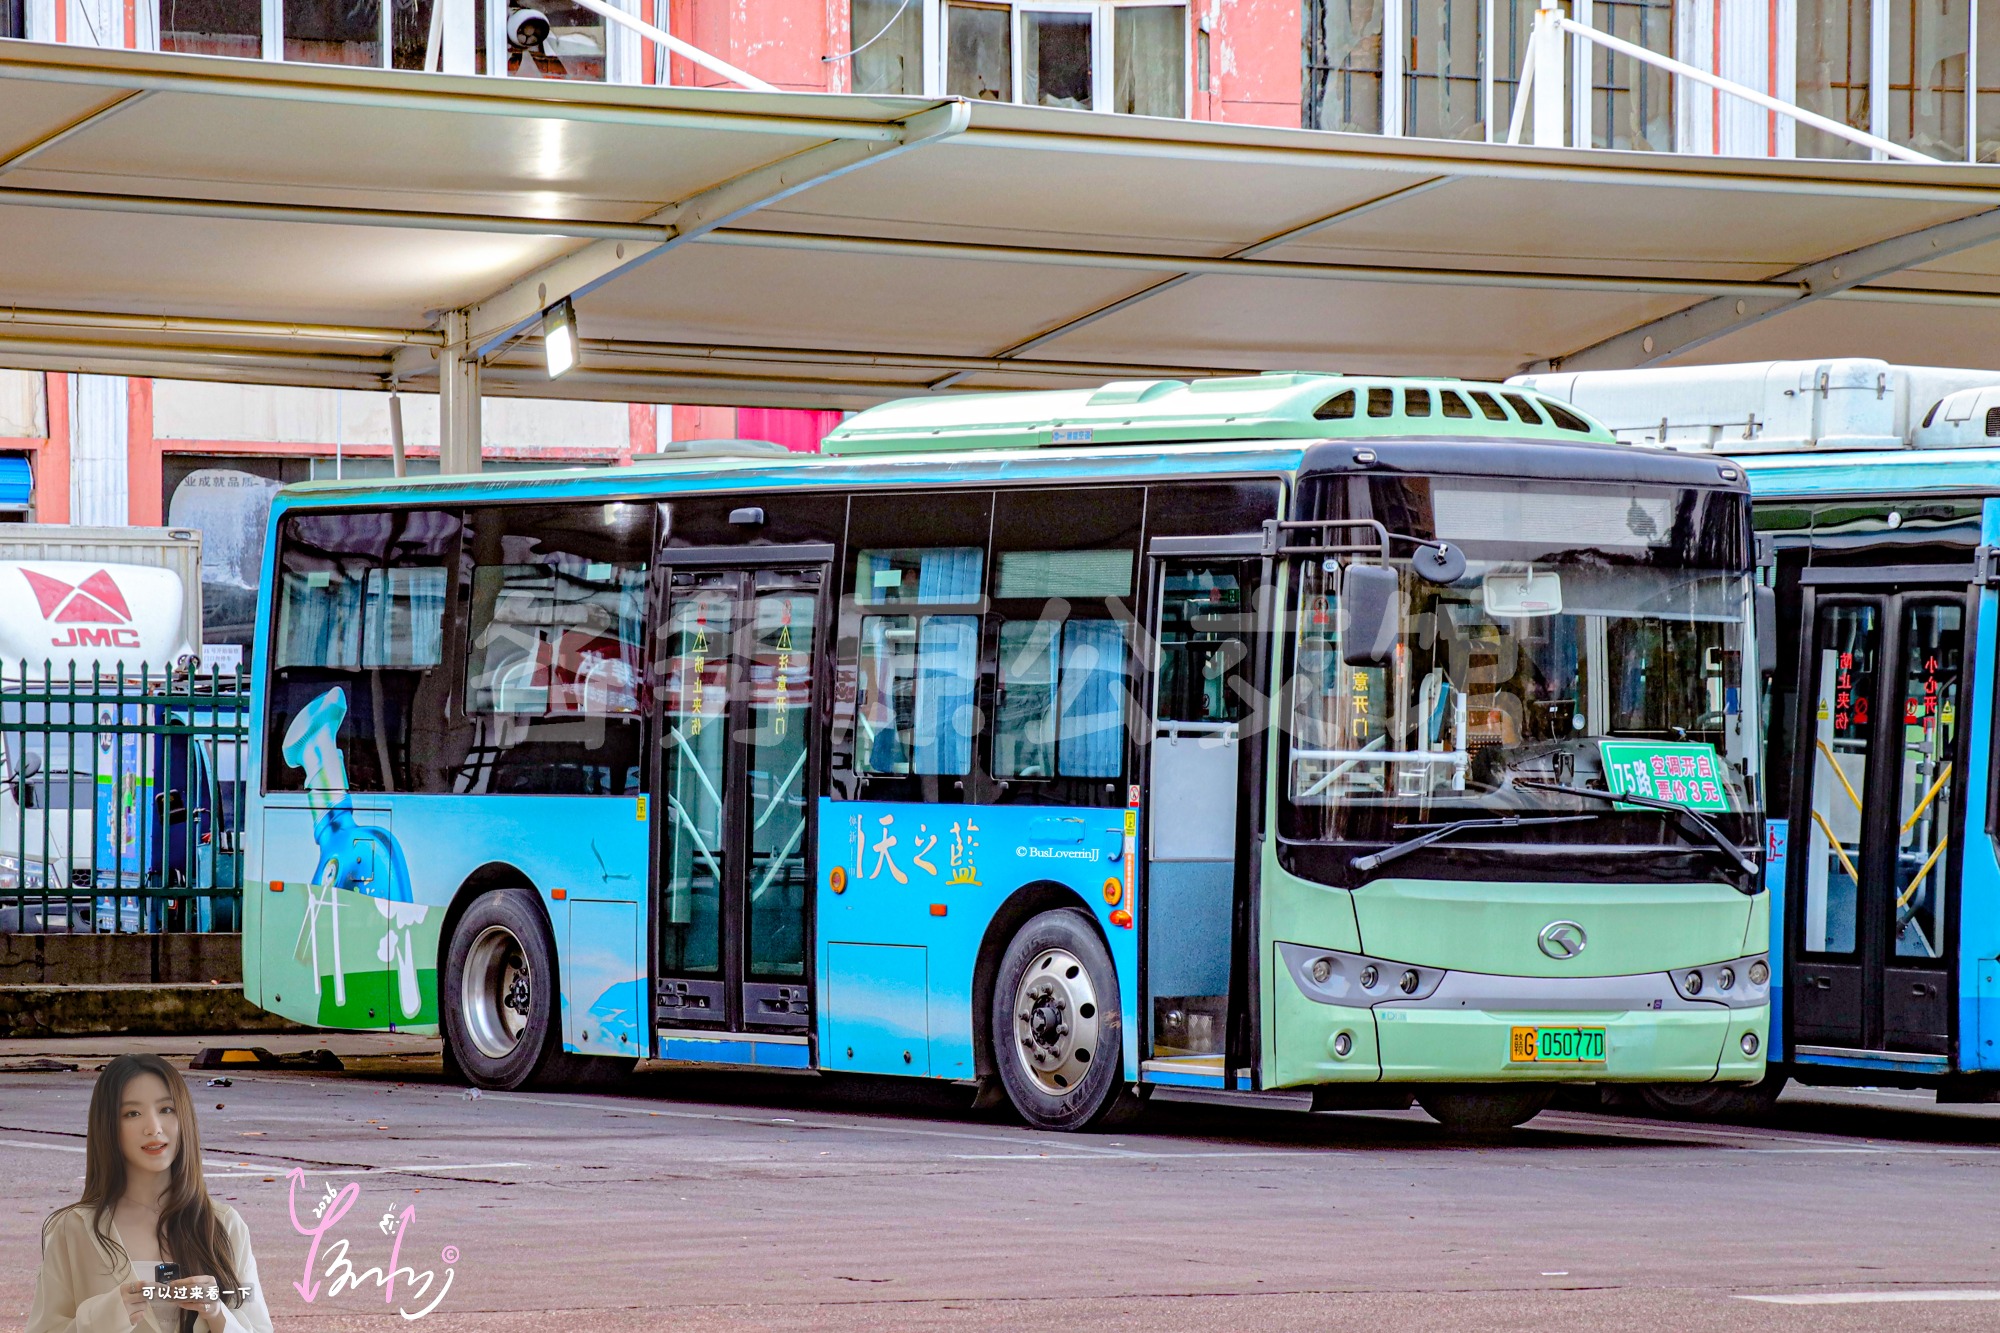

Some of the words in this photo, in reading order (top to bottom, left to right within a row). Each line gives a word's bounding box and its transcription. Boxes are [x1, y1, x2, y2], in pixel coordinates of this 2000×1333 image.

[51, 628, 140, 648] JMC
[1650, 755, 1713, 777] 空调开启
[1614, 760, 1653, 796] 75路
[1656, 780, 1719, 801] 票价3元
[1542, 1032, 1604, 1056] 05077D
